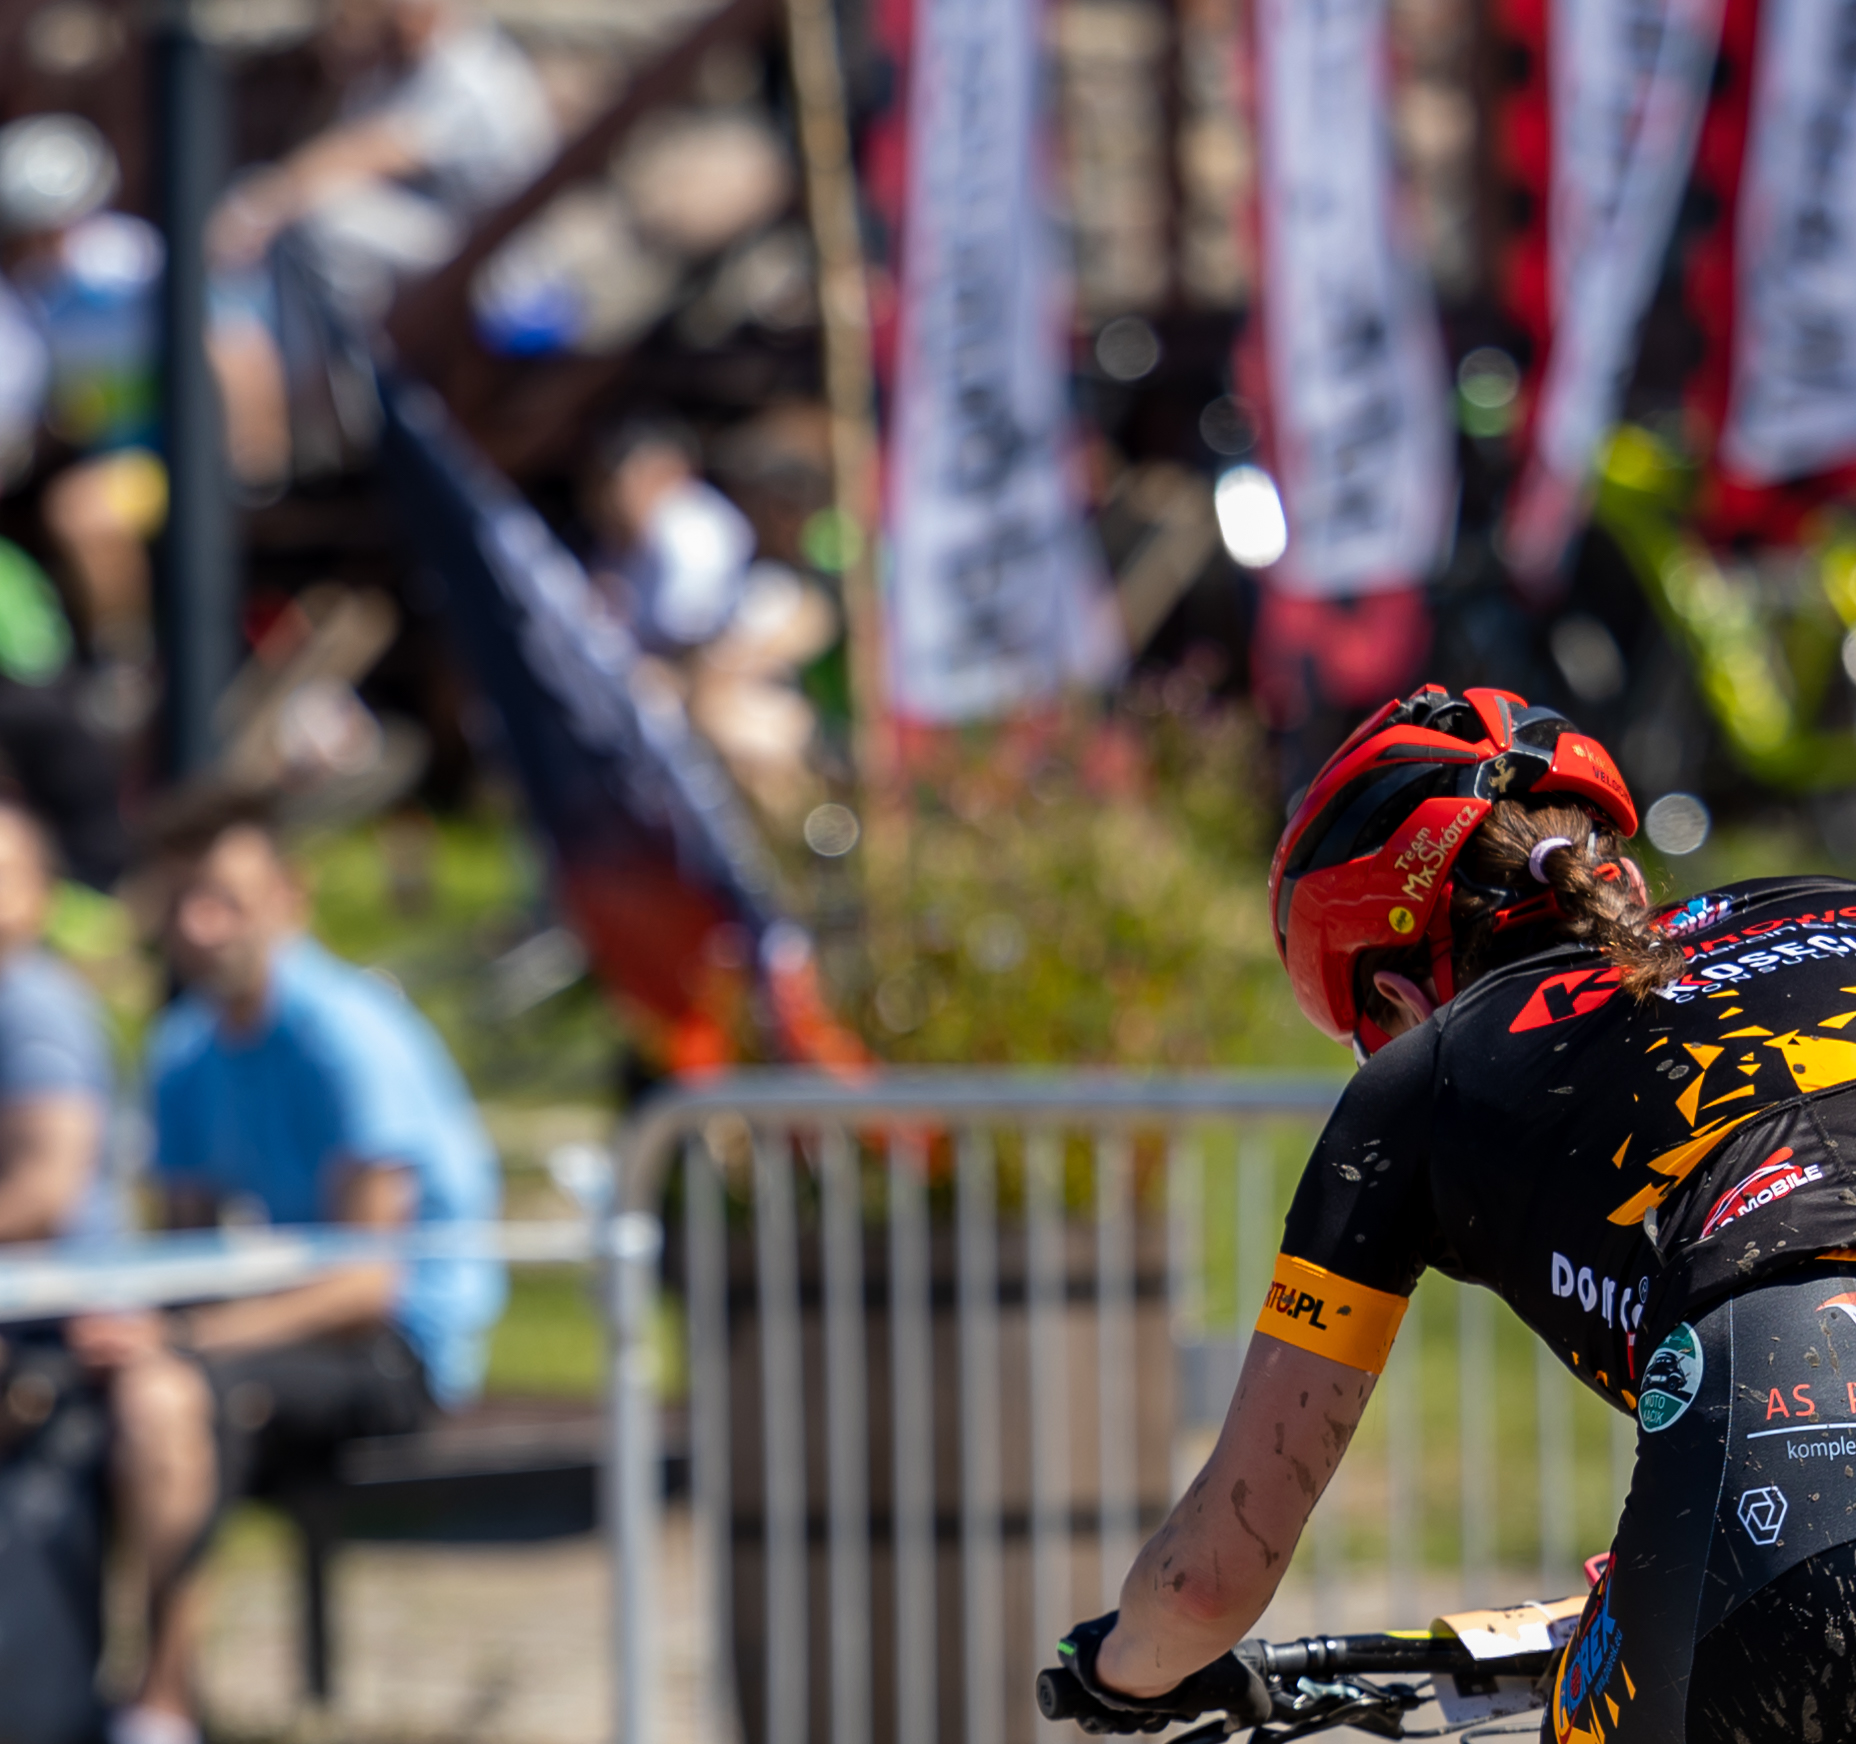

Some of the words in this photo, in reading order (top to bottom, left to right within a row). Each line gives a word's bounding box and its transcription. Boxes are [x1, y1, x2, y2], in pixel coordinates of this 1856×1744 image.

[1394, 827, 1431, 870] Team
[1737, 1164, 1823, 1217] MOBILE
[1766, 1384, 1816, 1421] AS
